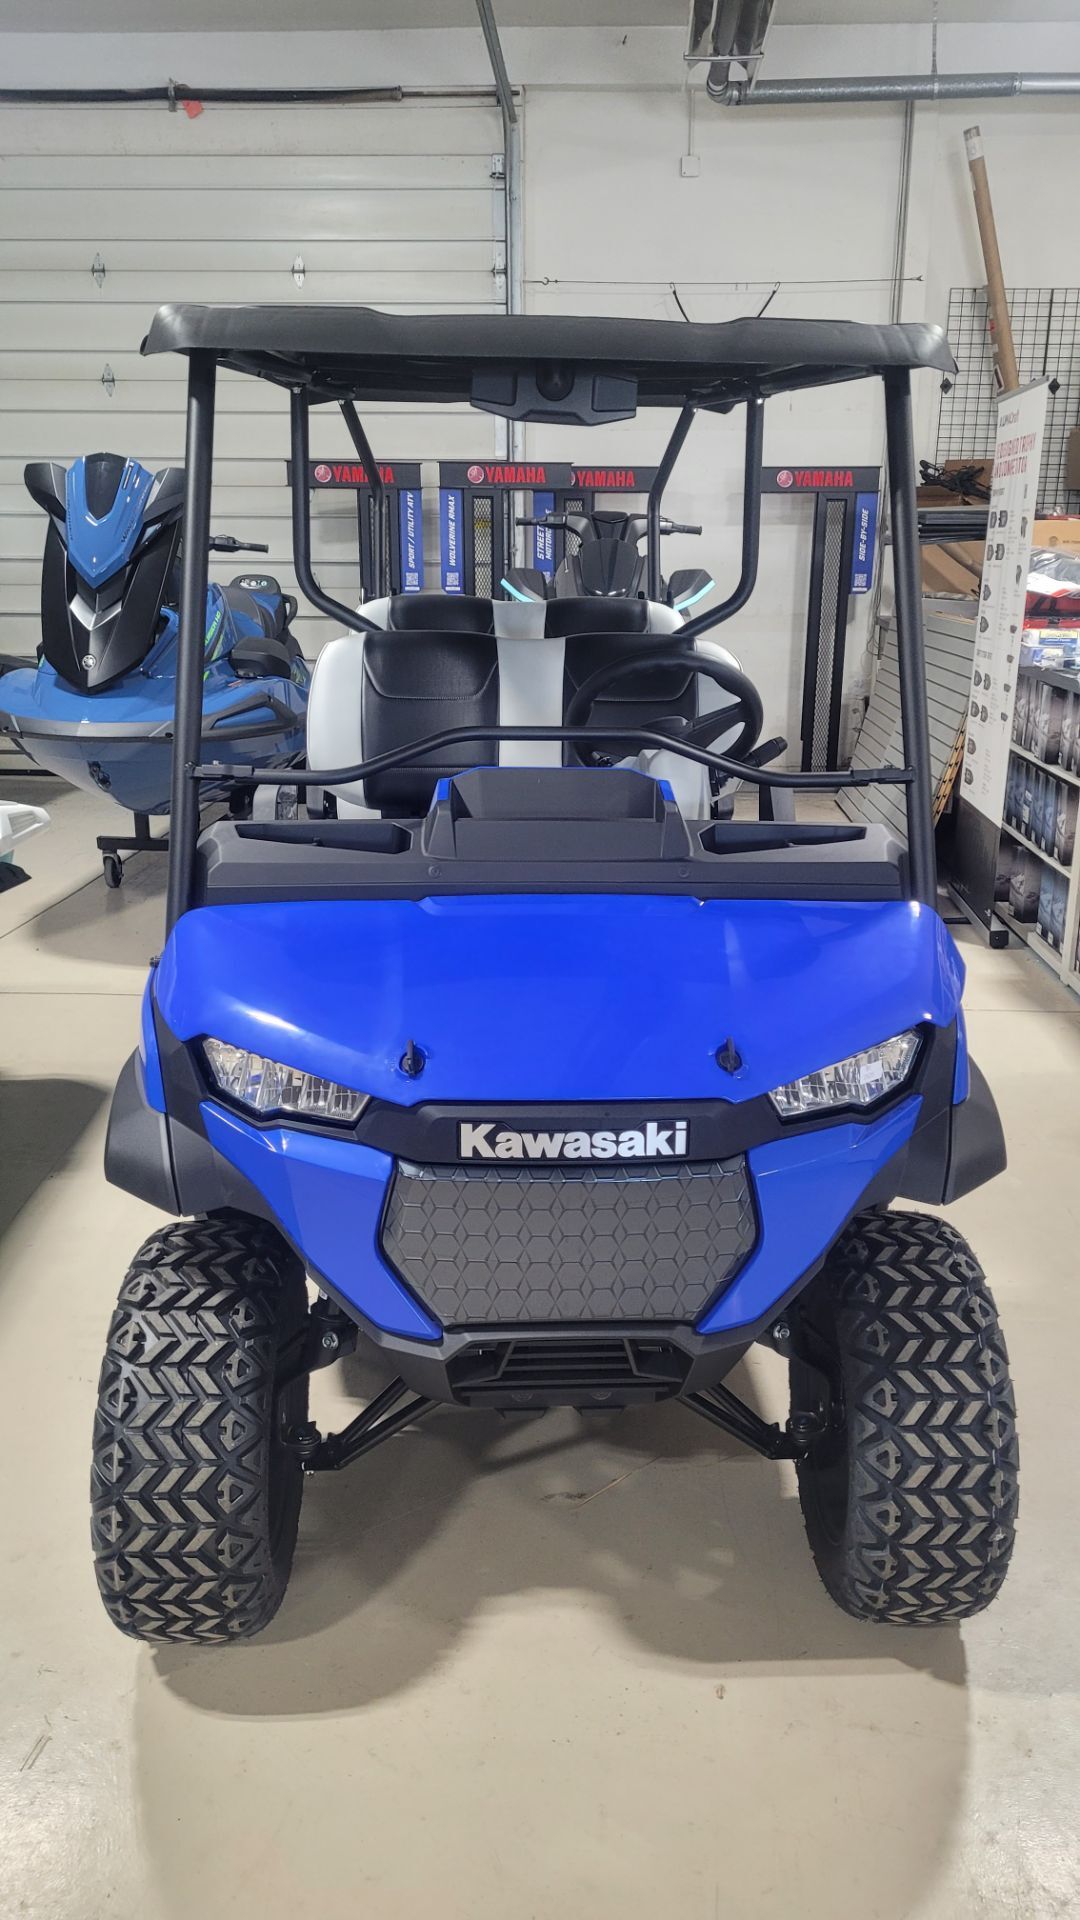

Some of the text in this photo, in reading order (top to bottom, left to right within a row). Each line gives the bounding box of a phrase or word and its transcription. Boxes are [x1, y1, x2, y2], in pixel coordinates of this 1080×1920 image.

[333, 465, 395, 484] YAMA
[485, 465, 546, 484] YAMAHA
[576, 471, 635, 487] YAMAHA
[794, 471, 854, 487] YAMAHA
[407, 491, 415, 509] ATV
[407, 509, 415, 538] UTILITY
[448, 495, 456, 567] WOLVERINE RMAX
[545, 508, 553, 560] MOTORCE
[858, 508, 869, 562] SIDE-BY-SIDE
[408, 543, 416, 569] SPORT
[536, 525, 545, 560] STREET
[460, 1121, 687, 1159] Kawasaki
